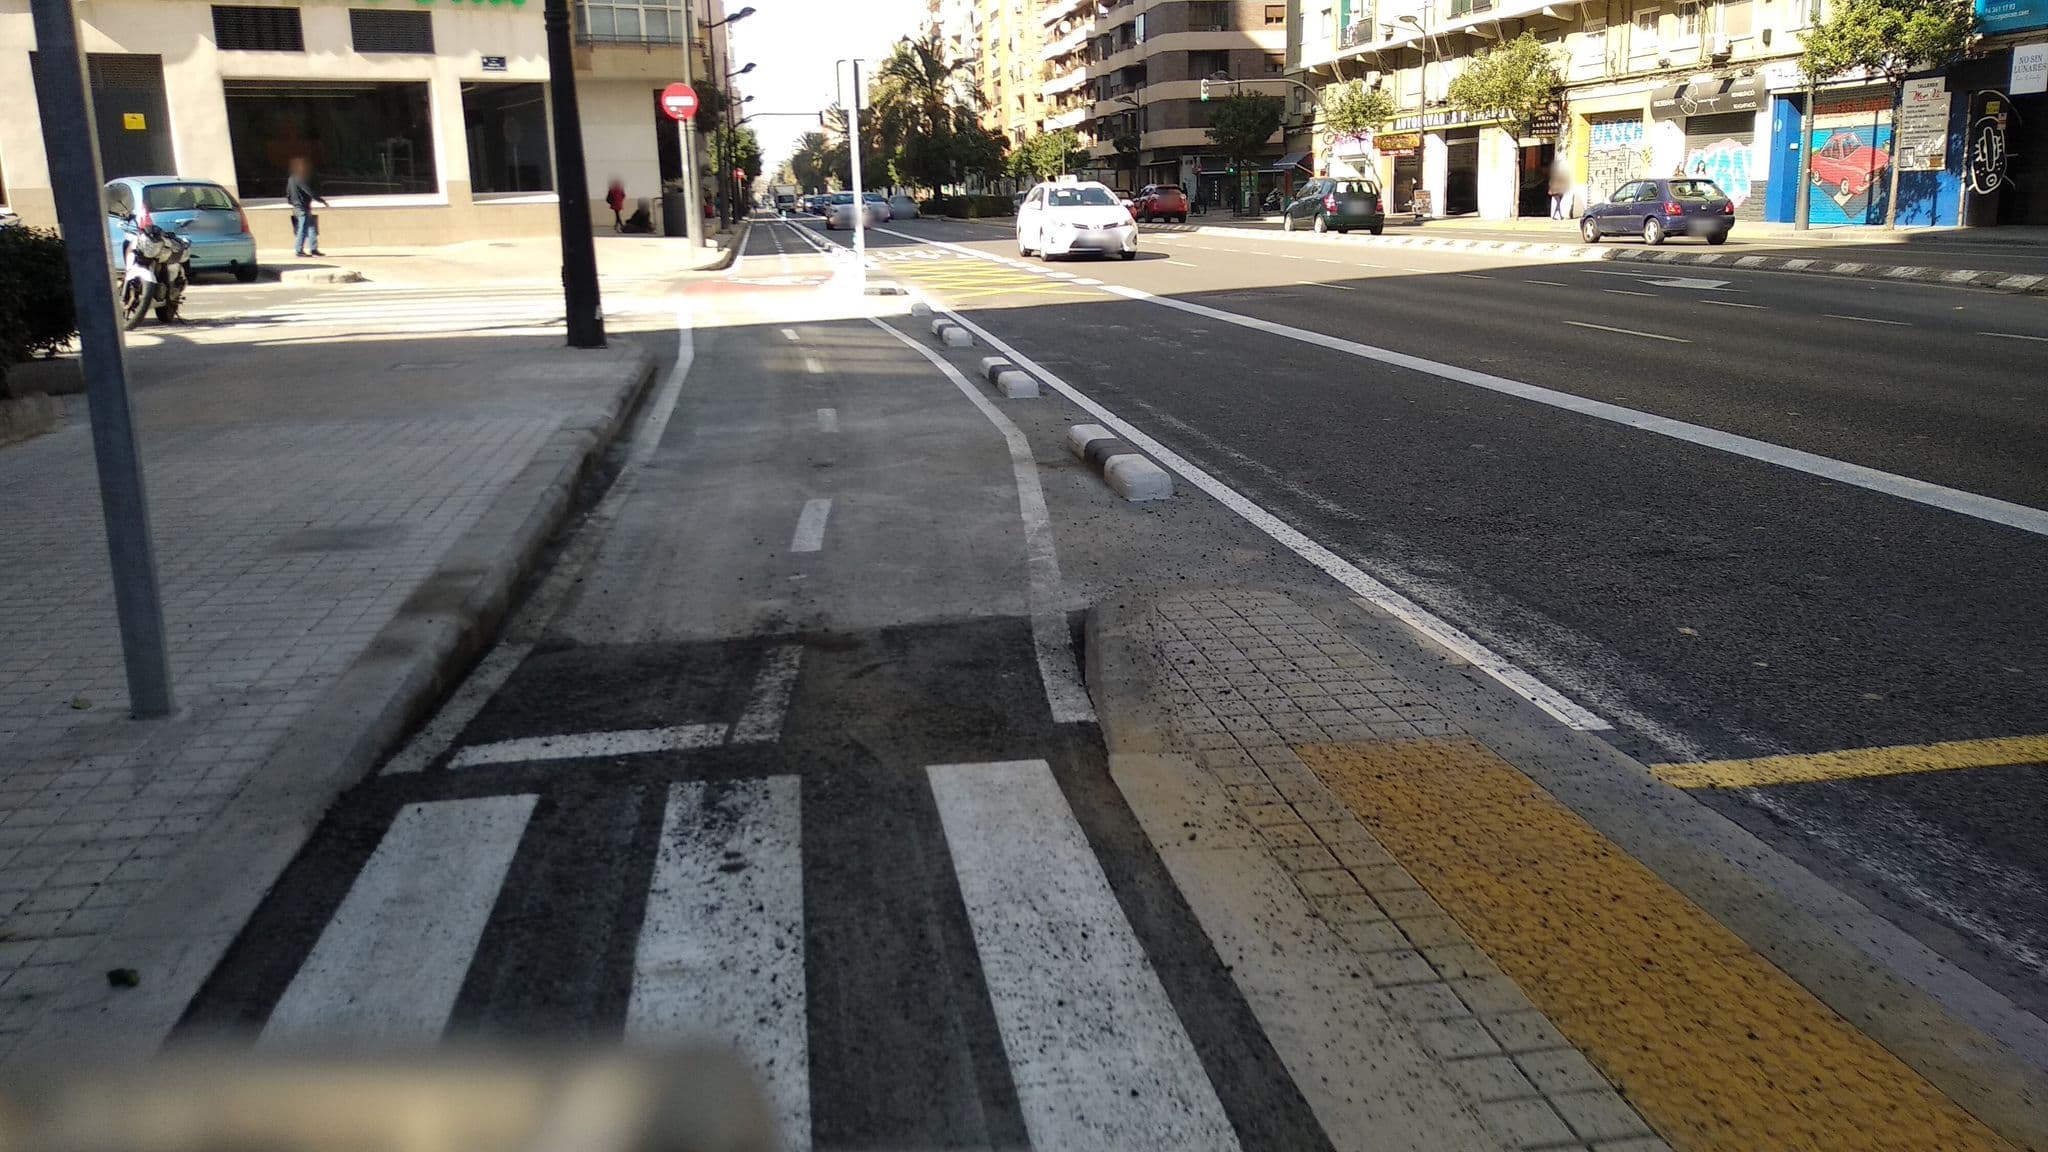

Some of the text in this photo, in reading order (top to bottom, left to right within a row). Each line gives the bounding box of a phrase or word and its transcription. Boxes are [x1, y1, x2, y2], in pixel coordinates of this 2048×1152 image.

[2019, 54, 2043, 64] NO SIN
[2014, 63, 2047, 74] LUNARES
